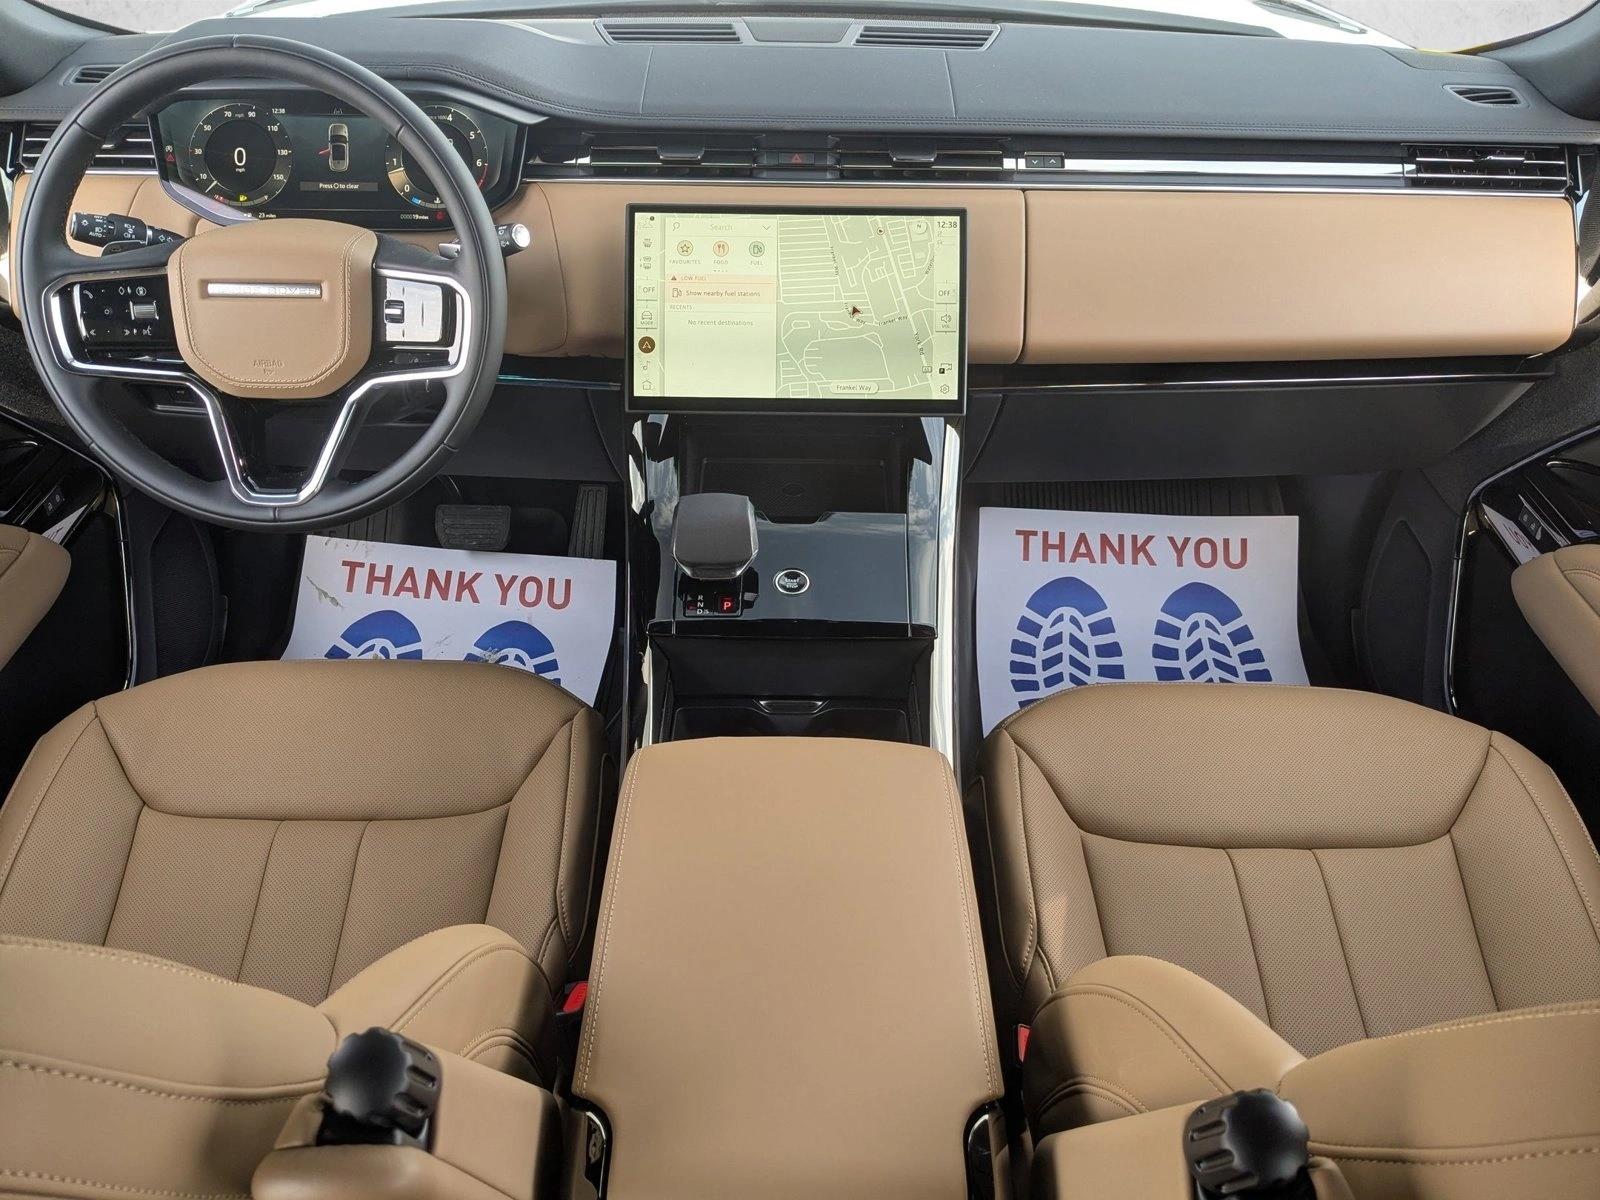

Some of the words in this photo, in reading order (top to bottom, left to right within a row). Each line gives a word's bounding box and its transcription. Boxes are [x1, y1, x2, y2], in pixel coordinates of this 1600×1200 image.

[469, 131, 475, 139] 5
[234, 147, 247, 166] 0
[476, 159, 482, 167] 6
[937, 221, 958, 229] 12:38
[703, 290, 724, 298] nearby
[859, 384, 872, 392] Way
[1015, 529, 1157, 568] THANK
[1167, 535, 1248, 570] YOU
[341, 559, 484, 605] THANK
[494, 572, 573, 611] YOU
[723, 601, 732, 610] P
